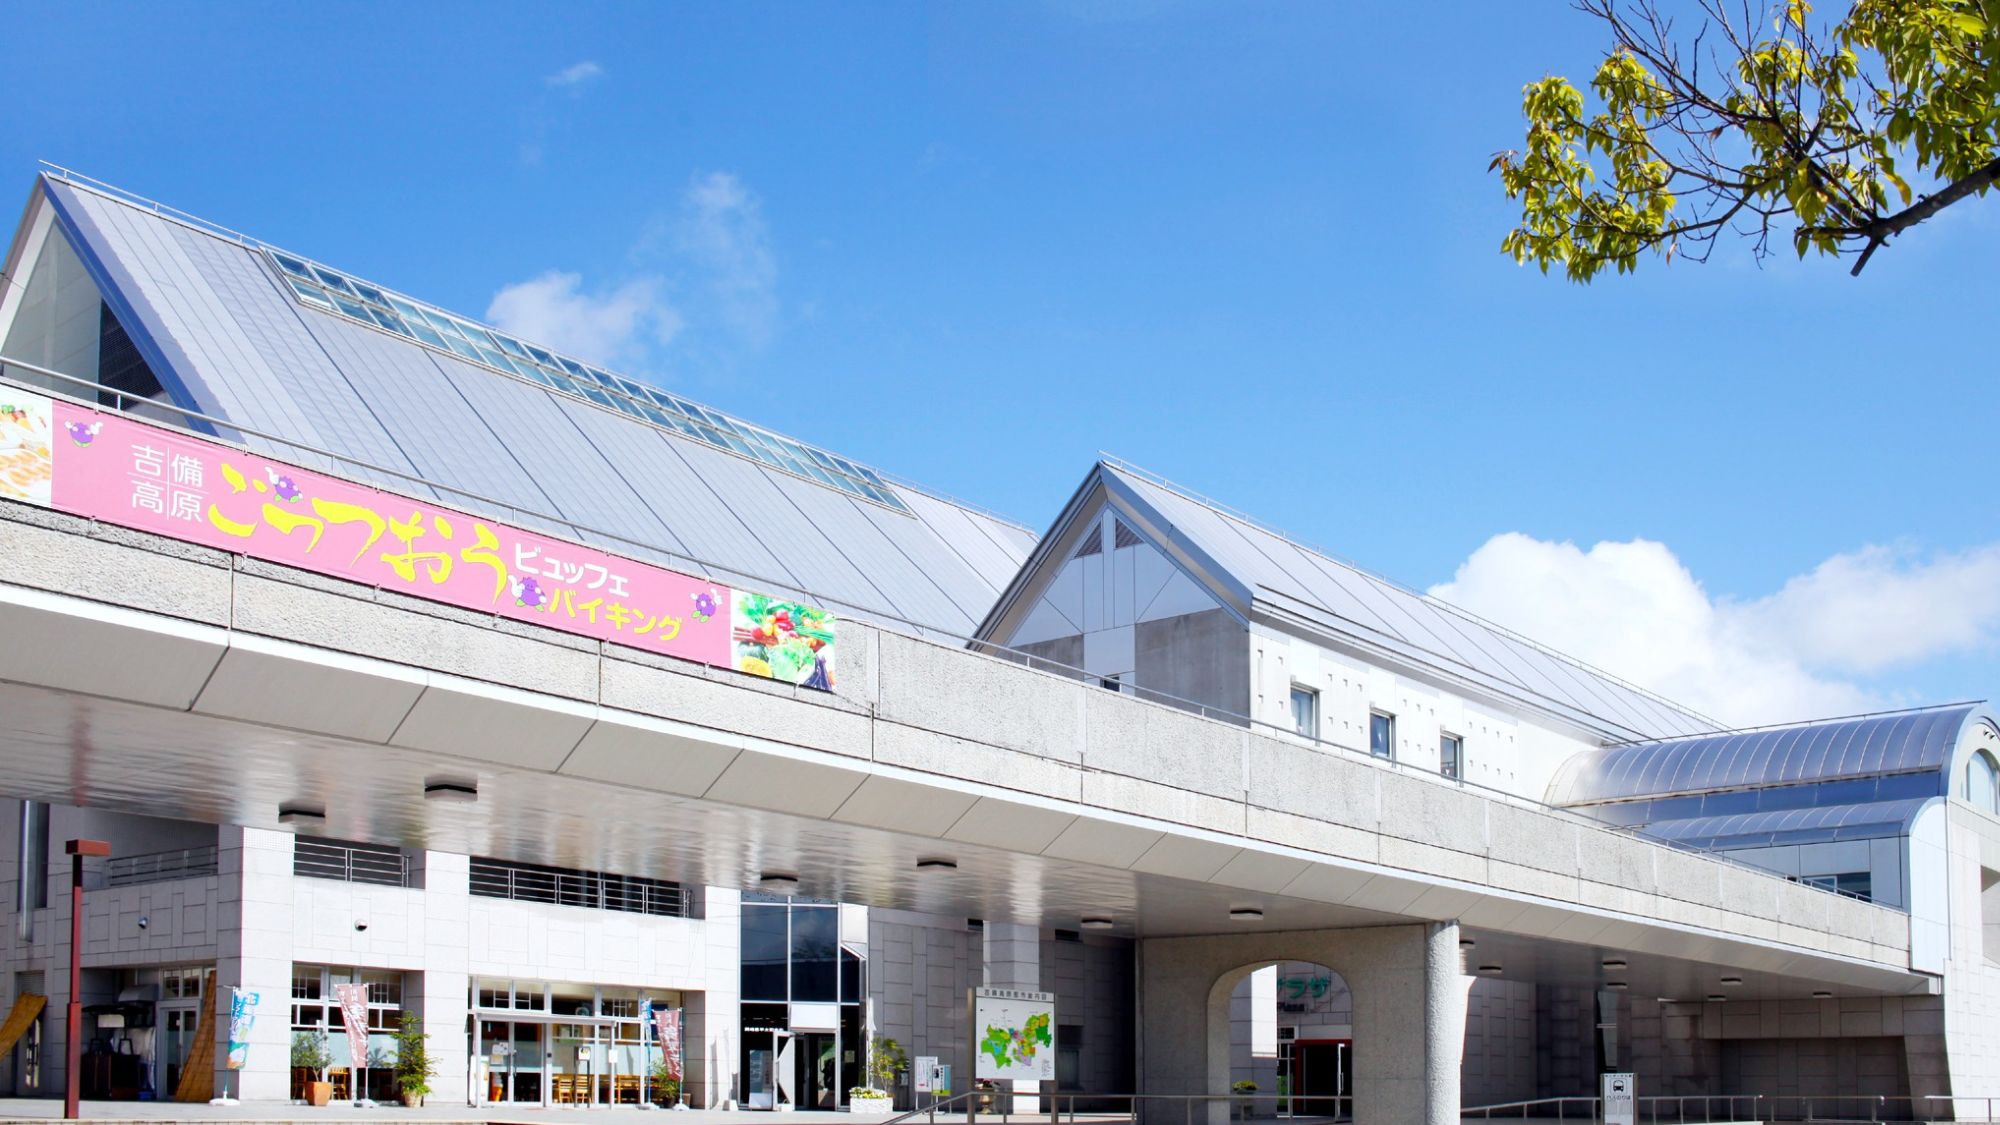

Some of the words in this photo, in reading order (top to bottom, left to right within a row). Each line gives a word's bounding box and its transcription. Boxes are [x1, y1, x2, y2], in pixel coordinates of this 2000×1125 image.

[131, 444, 203, 487] 吉備
[131, 479, 203, 523] 高原
[515, 542, 630, 598] ビュッフェ
[549, 586, 683, 641] バイキング
